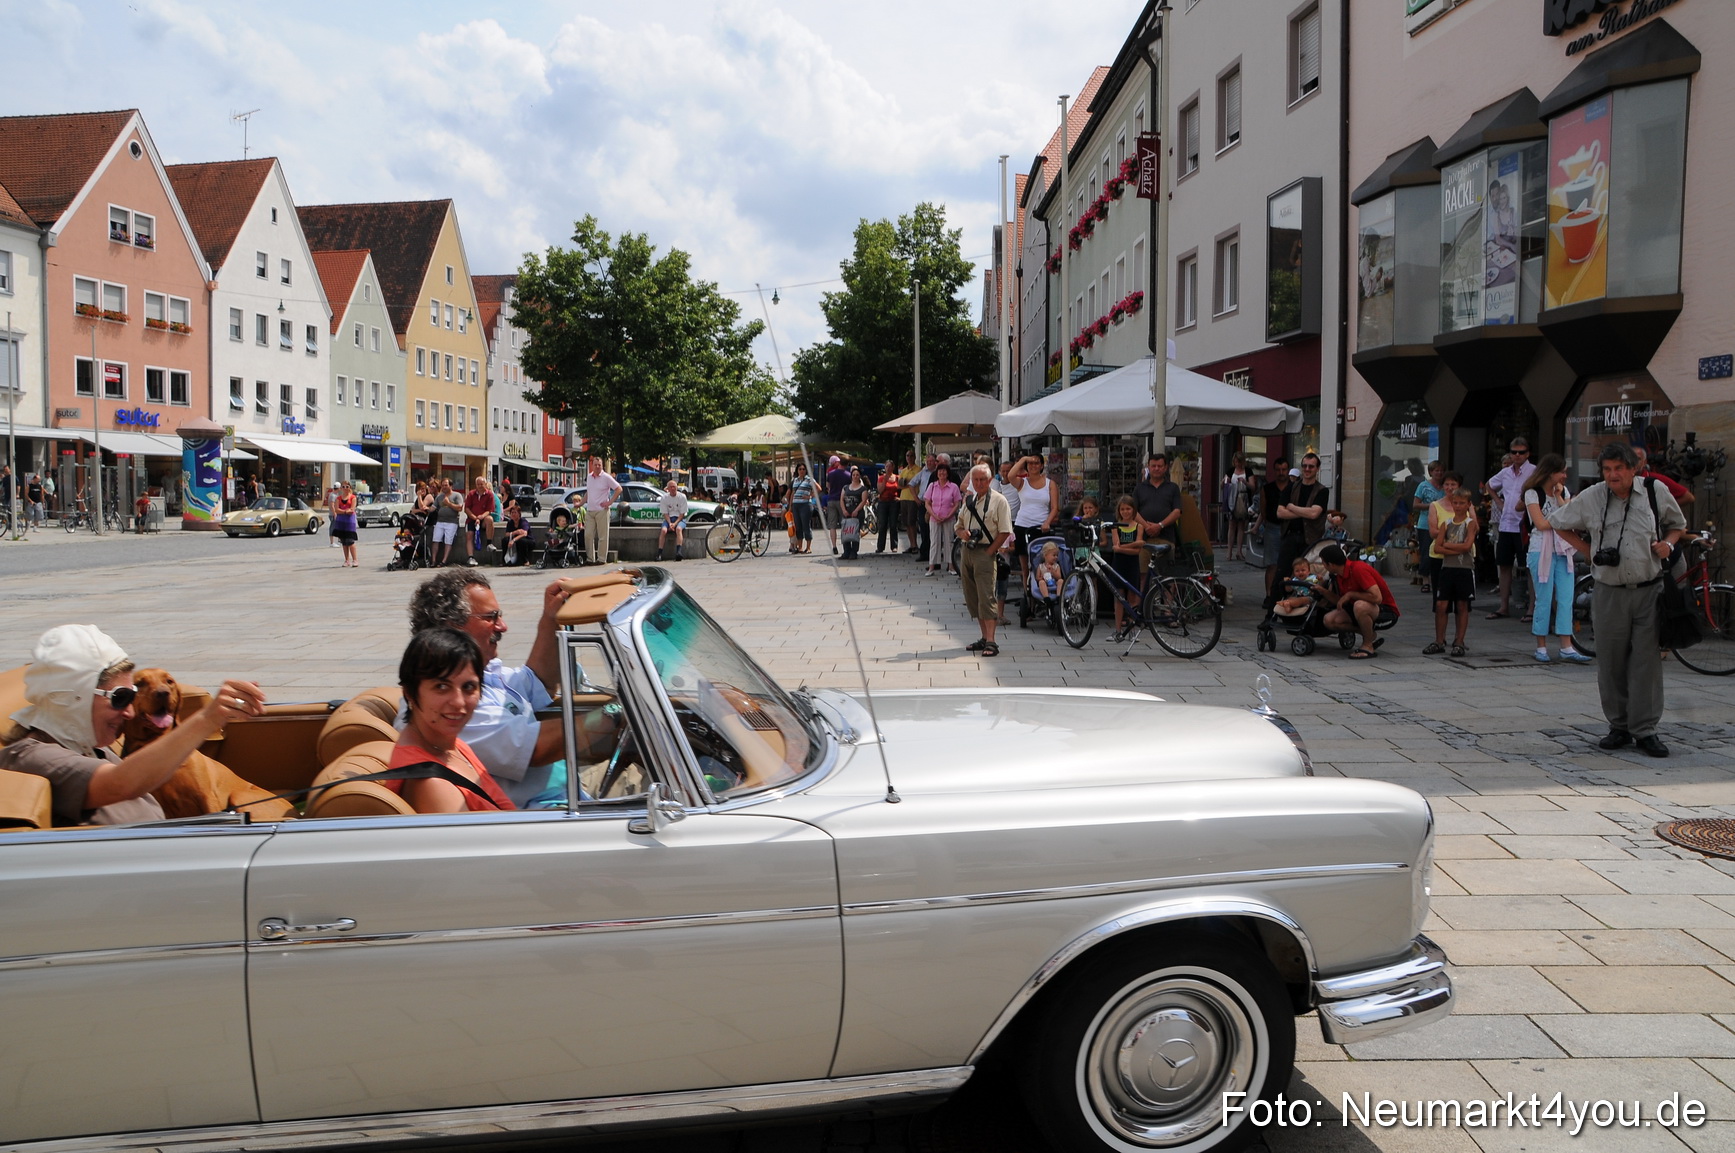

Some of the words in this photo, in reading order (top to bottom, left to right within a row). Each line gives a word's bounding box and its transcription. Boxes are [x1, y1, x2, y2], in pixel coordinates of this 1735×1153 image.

[1565, 32, 1595, 56] am
[1142, 146, 1157, 194] Achatz
[1445, 179, 1474, 210] RACKL
[1604, 405, 1632, 427] RACKL
[1400, 423, 1417, 439] RACKL
